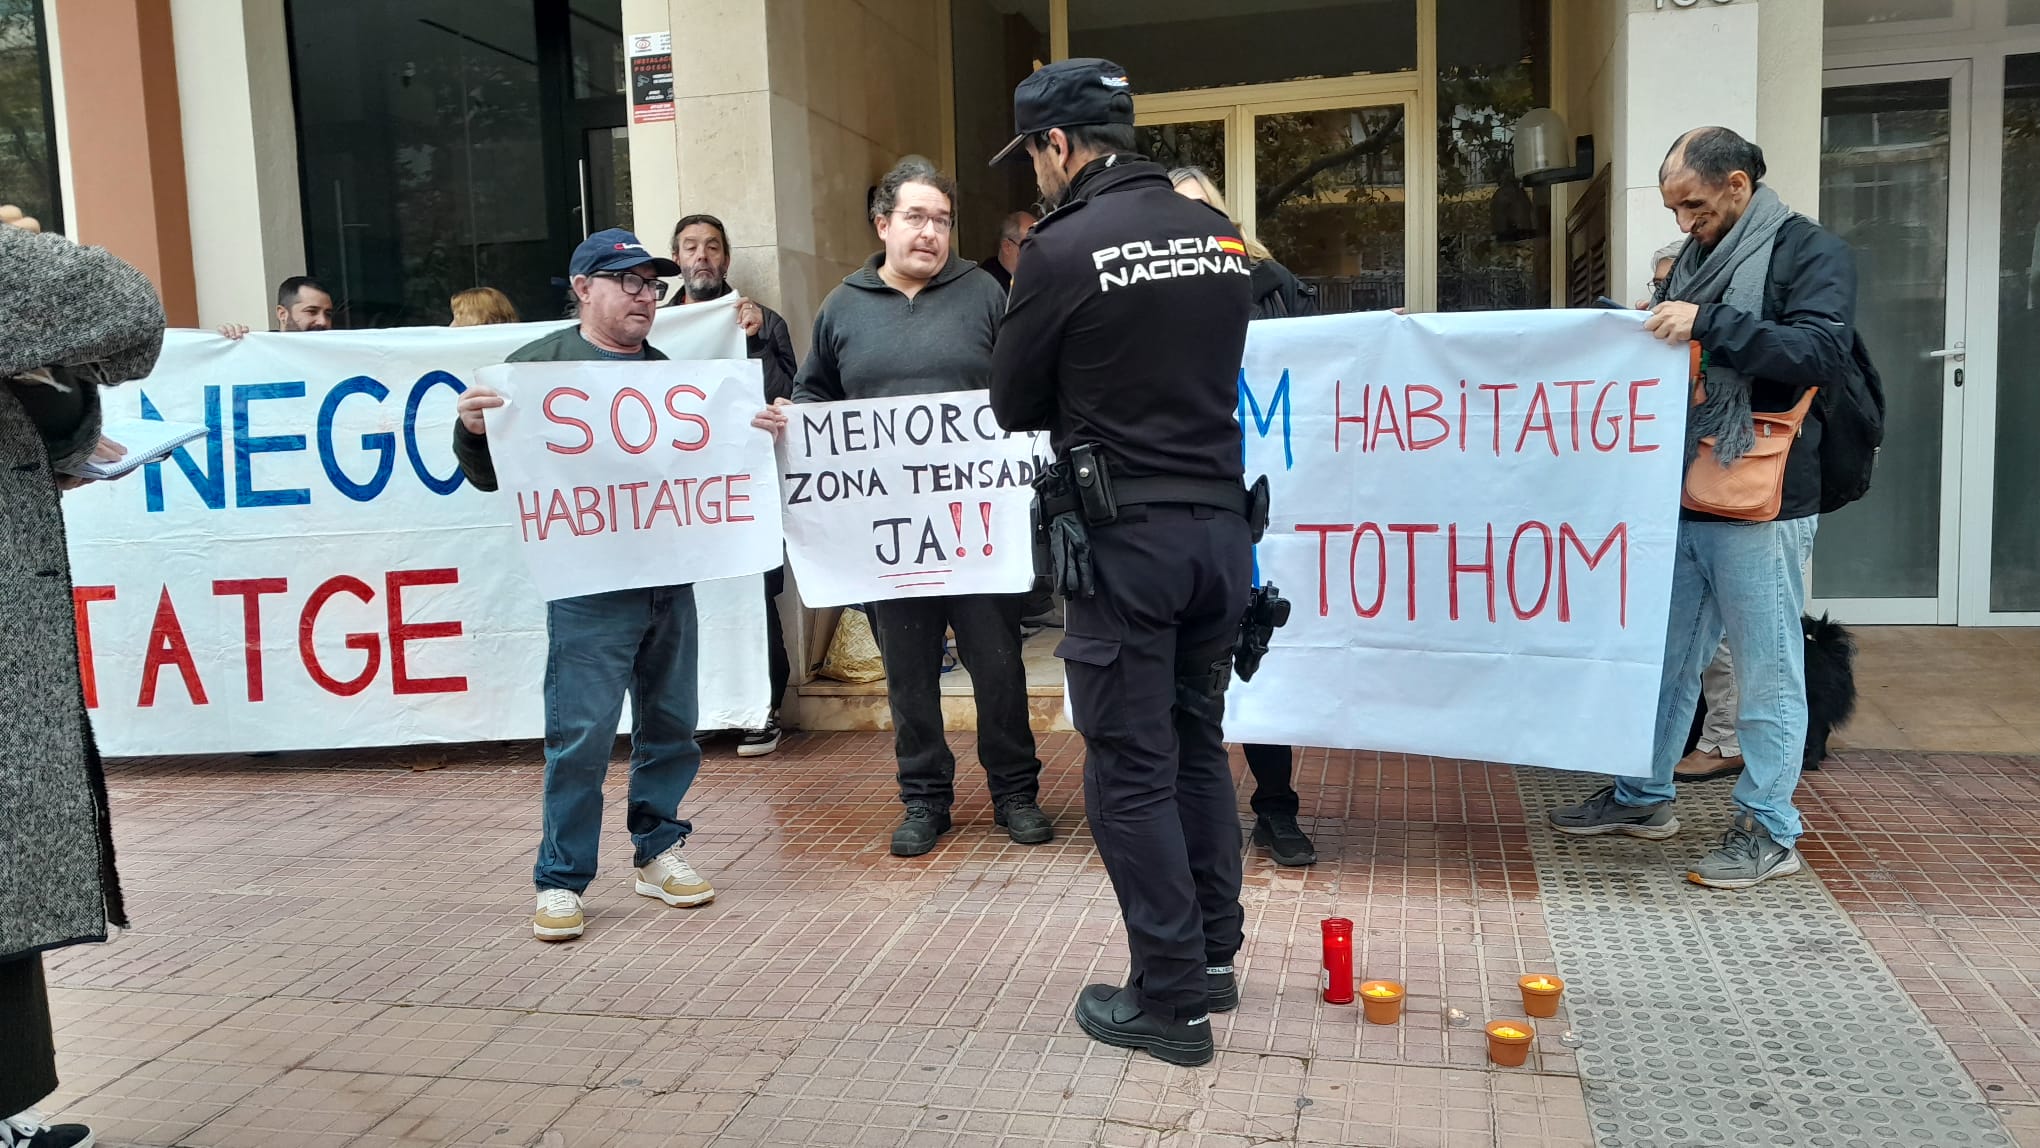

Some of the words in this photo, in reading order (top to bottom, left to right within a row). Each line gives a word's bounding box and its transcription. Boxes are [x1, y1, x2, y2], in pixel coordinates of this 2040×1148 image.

[1092, 235, 1224, 270] POLICIA
[1099, 256, 1251, 292] NACIONAL
[543, 384, 711, 455] SOS
[803, 403, 1036, 458] MENORC
[518, 473, 754, 542] HABITATGE
[785, 468, 888, 505] ZONA
[872, 502, 993, 565] JA!!
[1295, 521, 1627, 629] TOTHOM
